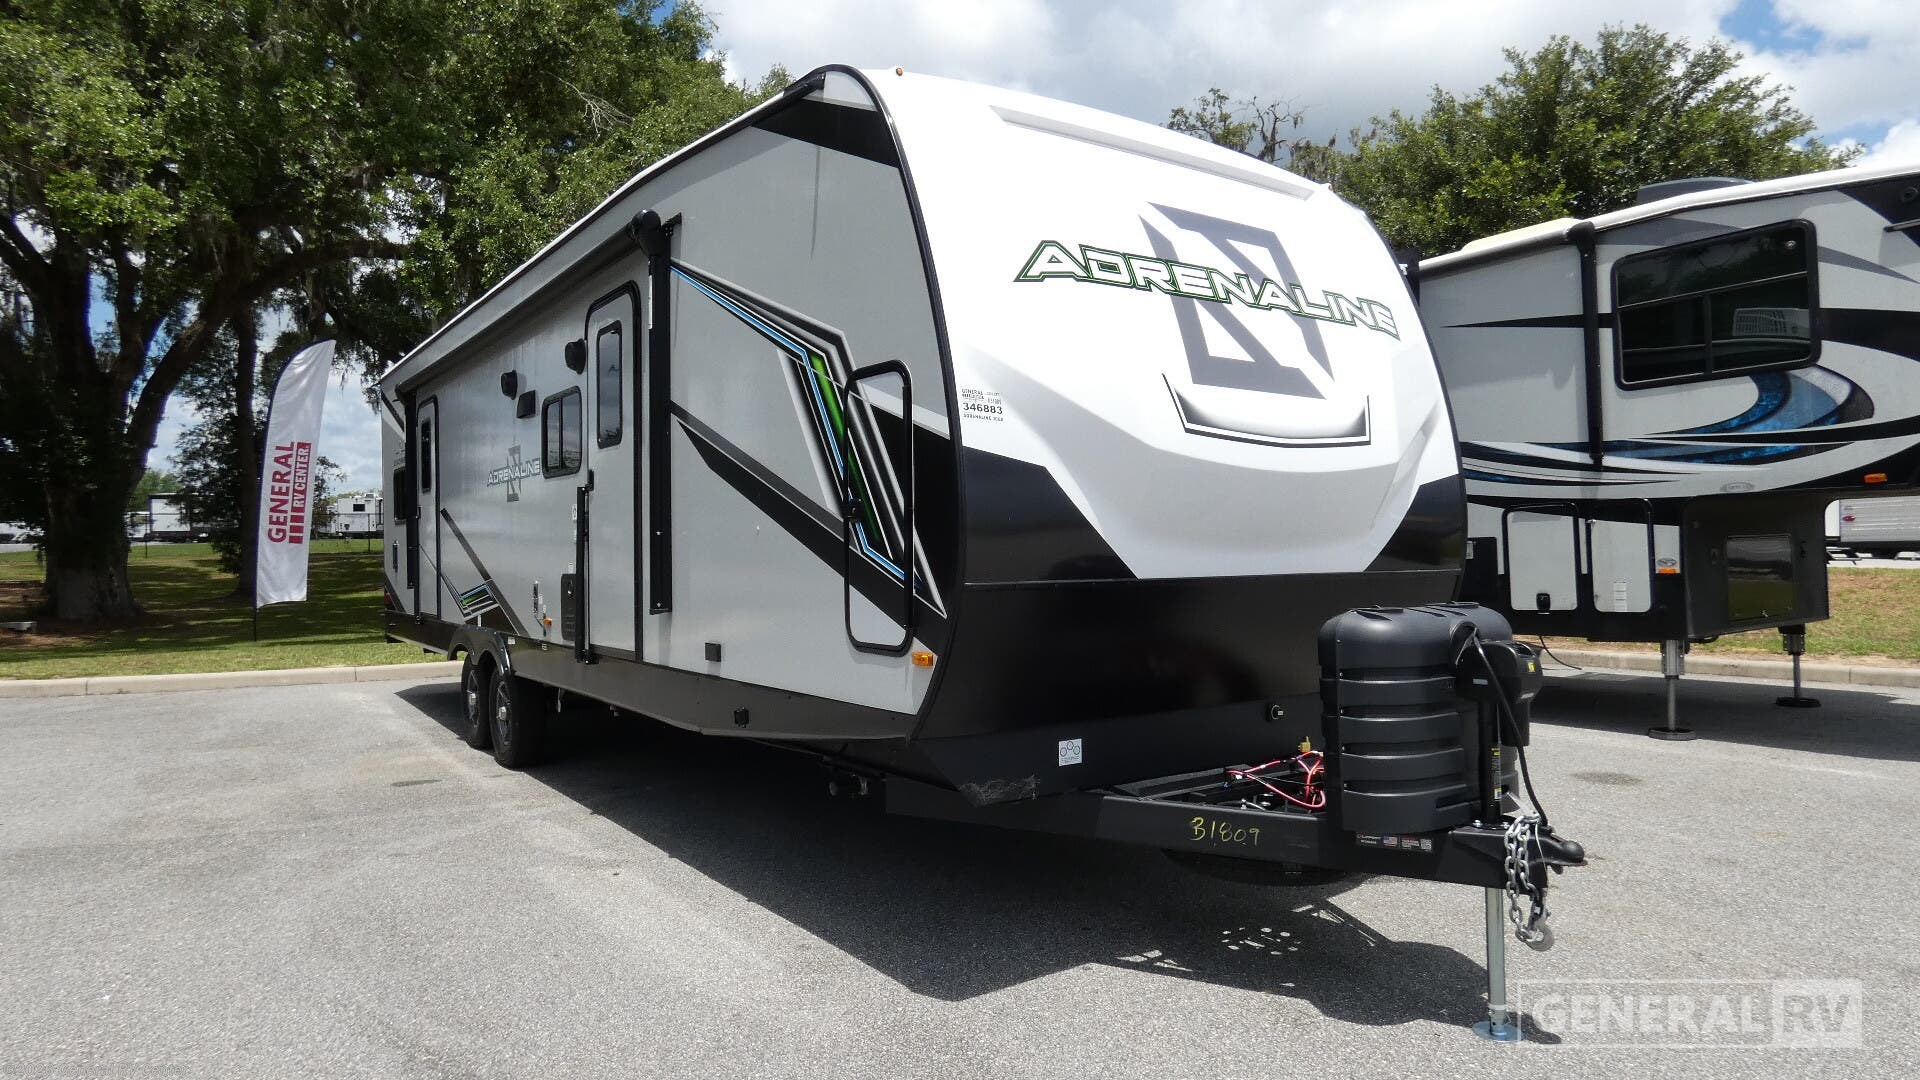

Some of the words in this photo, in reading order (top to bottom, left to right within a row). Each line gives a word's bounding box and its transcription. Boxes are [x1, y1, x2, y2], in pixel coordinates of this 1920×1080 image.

[1014, 240, 1400, 341] ADRENALINE
[962, 402, 1003, 415] 346883
[487, 457, 541, 487] ADRENALINE
[267, 441, 295, 543] GENERAL
[293, 493, 305, 508] RV
[1191, 816, 1260, 845] B1809
